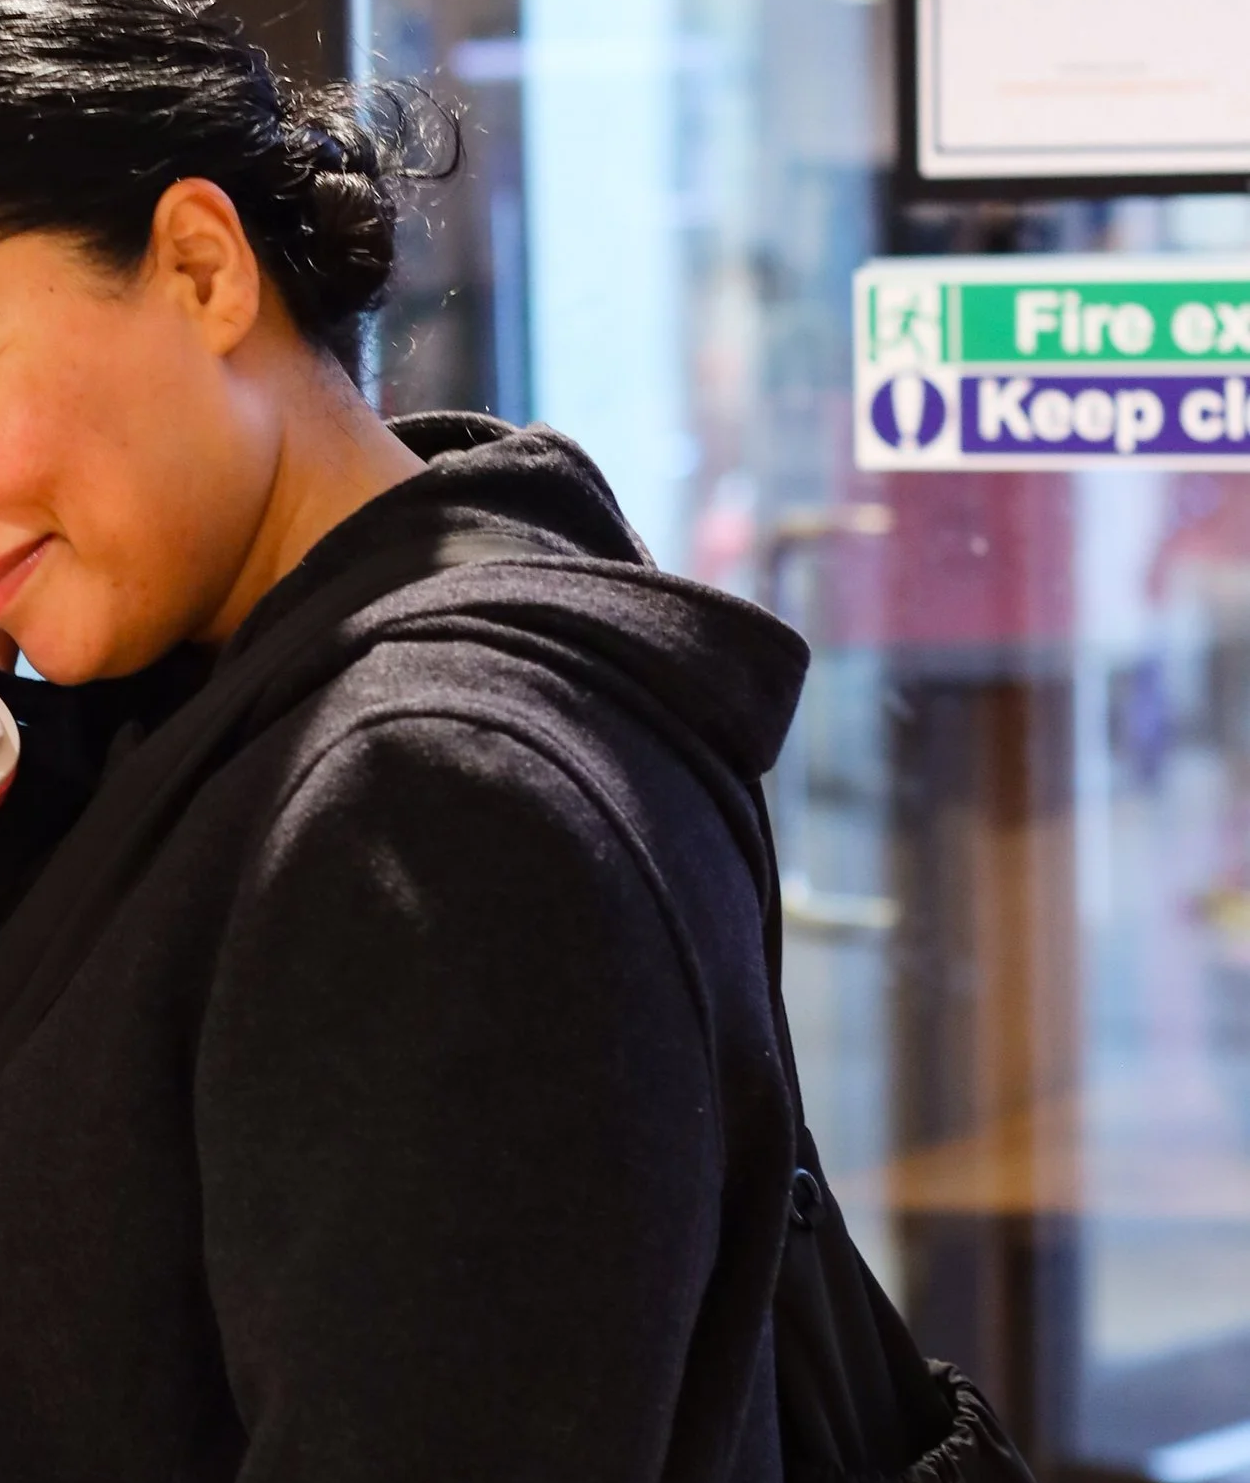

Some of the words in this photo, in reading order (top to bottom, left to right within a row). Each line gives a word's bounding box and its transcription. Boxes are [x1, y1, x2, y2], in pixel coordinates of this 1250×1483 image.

[1015, 289, 1155, 355] Fire
[977, 377, 1164, 455] Keep
[1179, 377, 1250, 443] cl
